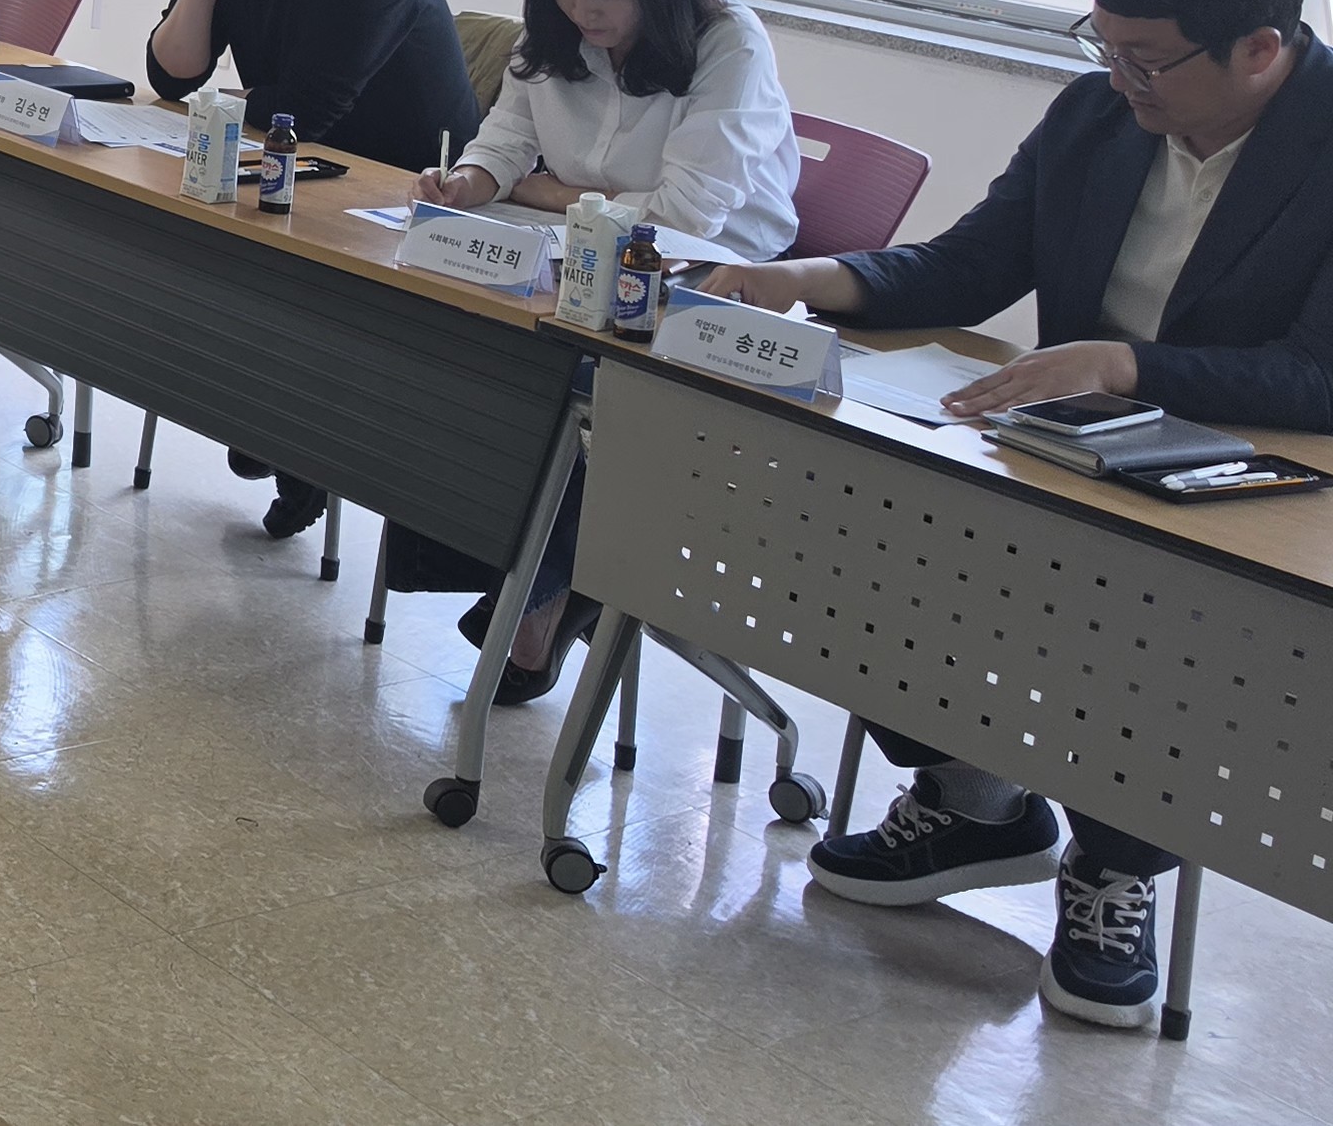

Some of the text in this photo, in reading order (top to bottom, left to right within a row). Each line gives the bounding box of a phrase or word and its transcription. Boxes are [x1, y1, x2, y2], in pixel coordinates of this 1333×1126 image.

[14, 97, 51, 123] 김승연
[428, 232, 522, 270] 사회복지사 최진희
[580, 248, 599, 272] 물
[694, 318, 800, 369] 직업지원 송완근
